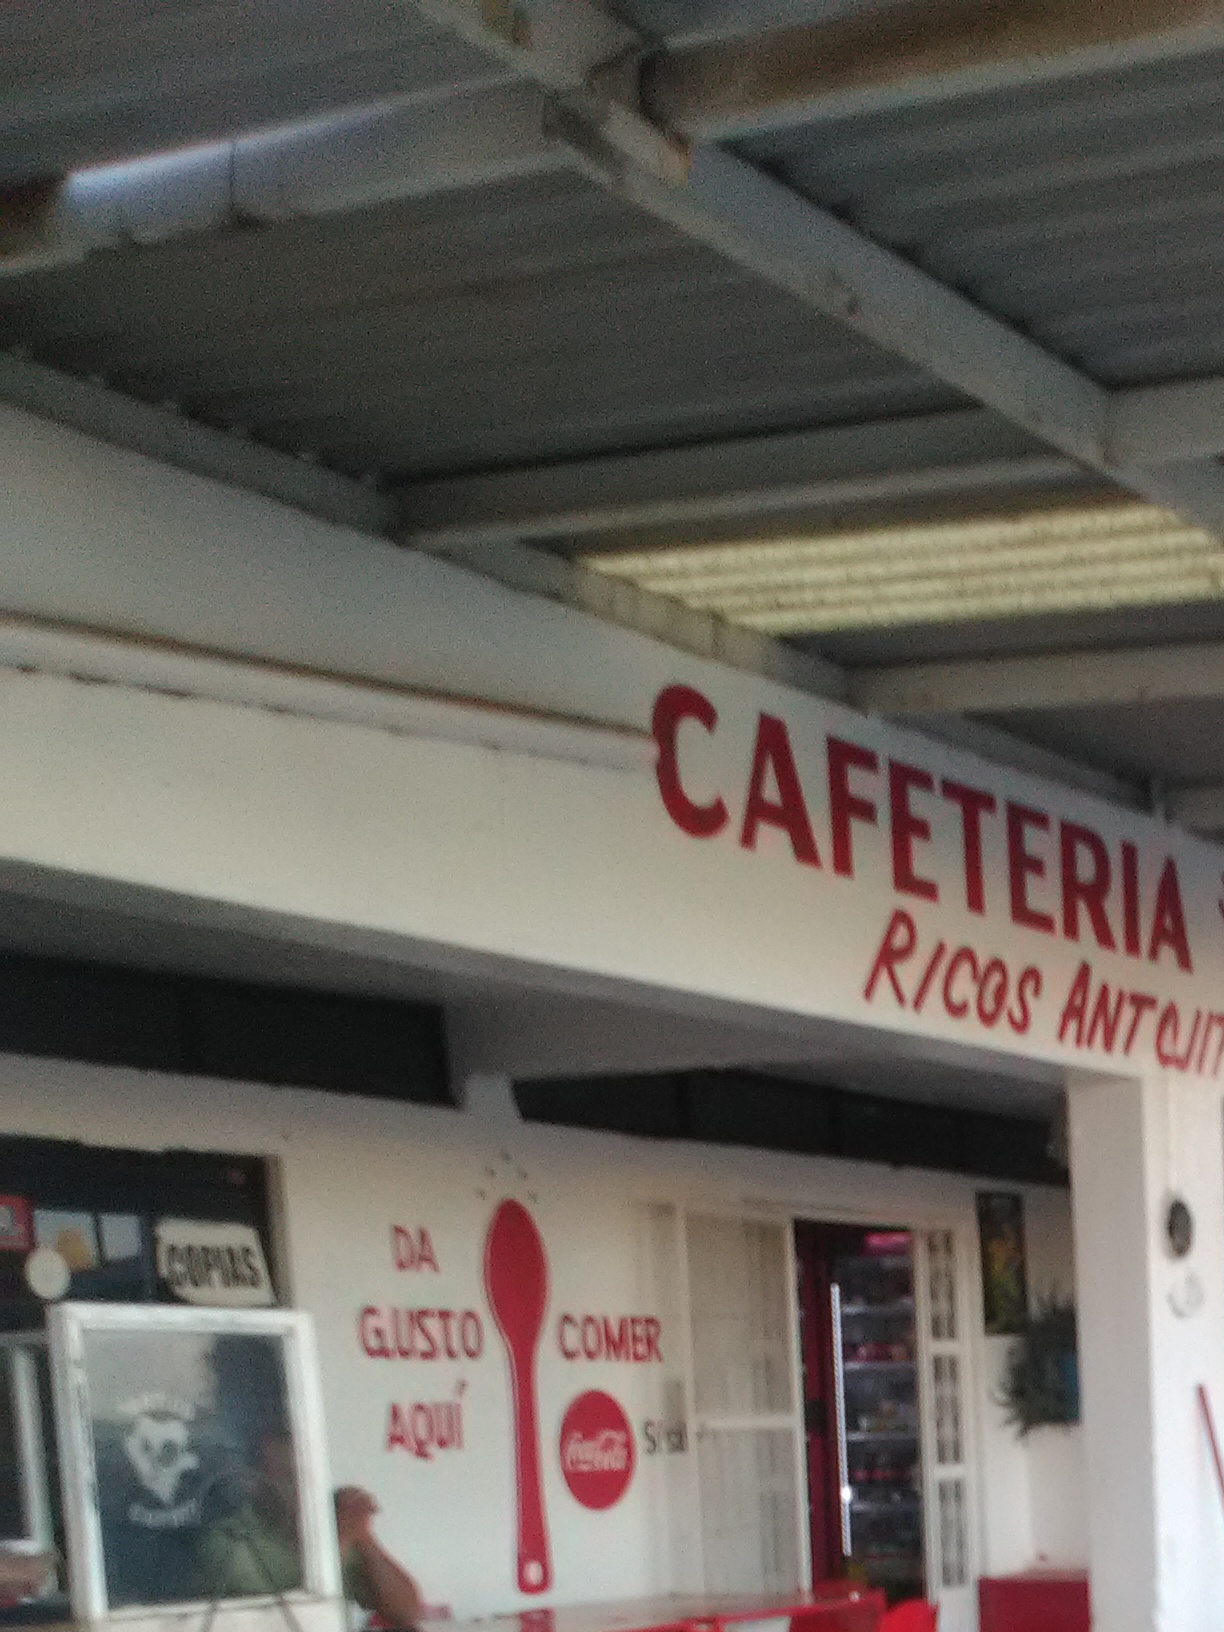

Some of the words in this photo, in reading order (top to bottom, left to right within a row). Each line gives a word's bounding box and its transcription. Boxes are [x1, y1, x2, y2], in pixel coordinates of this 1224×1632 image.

[652, 683, 1194, 975] CAFETERIA
[864, 908, 1042, 1035] RICOS
[391, 1223, 440, 1274] DA
[359, 1306, 484, 1360] GUSTO
[558, 1314, 663, 1363] COMER
